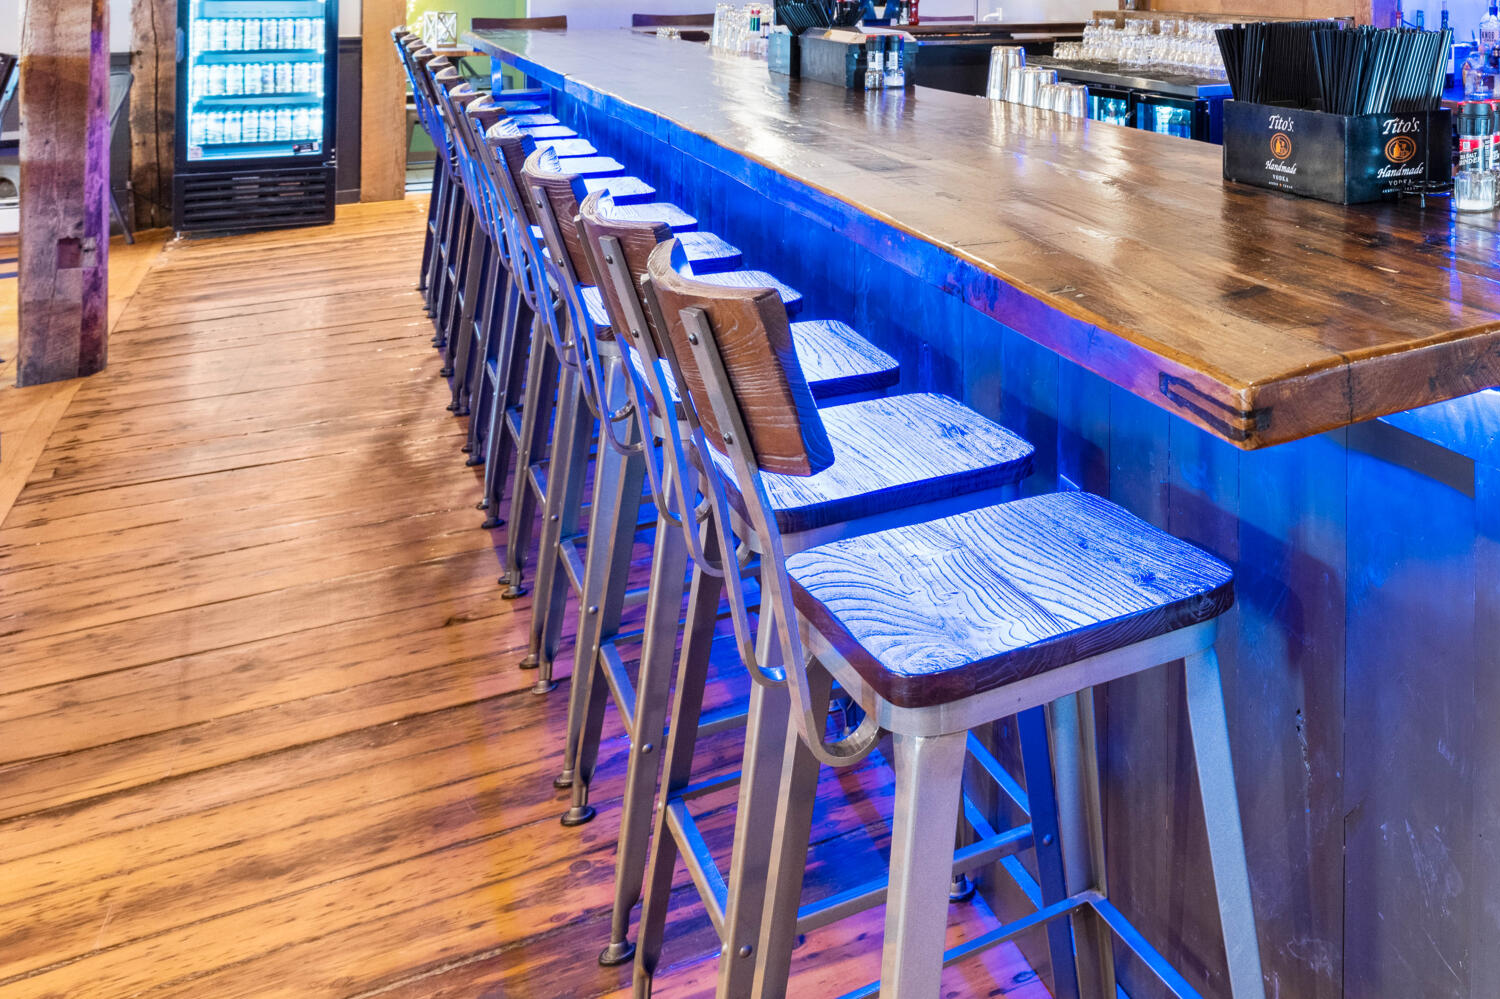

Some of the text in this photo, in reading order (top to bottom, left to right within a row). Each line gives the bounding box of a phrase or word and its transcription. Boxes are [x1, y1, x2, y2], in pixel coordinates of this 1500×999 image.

[1268, 114, 1294, 132] Tito's
[1382, 117, 1420, 135] Tito's
[1377, 162, 1425, 179] Handmade
